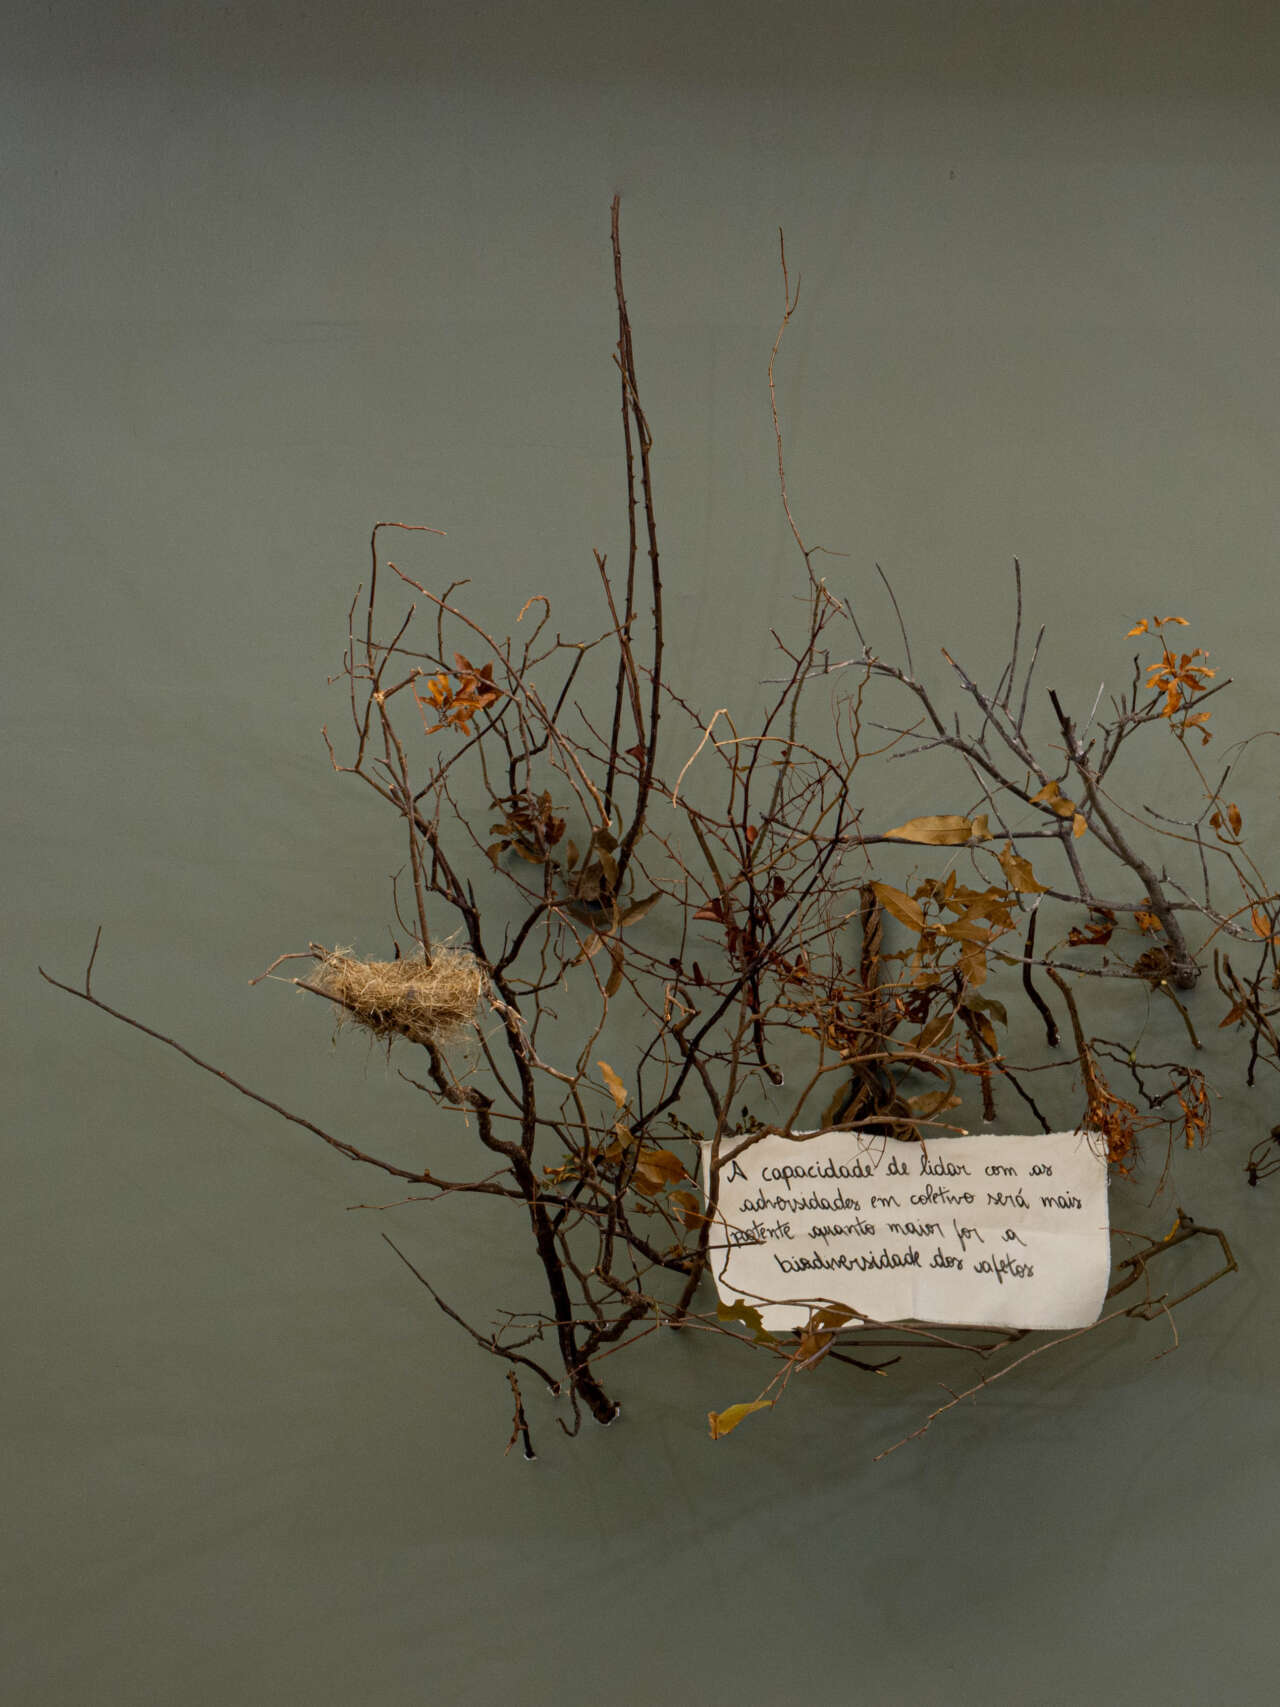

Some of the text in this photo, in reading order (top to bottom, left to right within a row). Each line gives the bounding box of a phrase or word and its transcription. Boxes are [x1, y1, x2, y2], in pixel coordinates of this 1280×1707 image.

[727, 1155, 1053, 1190] A capacidade de lidar com as
[870, 1194, 900, 1209] em
[910, 1184, 976, 1205] coletivo
[987, 1188, 1030, 1210] será
[1041, 1191, 1082, 1210] mais
[808, 1217, 875, 1246] quanto
[888, 1219, 945, 1239] maior
[953, 1219, 984, 1252] for
[1001, 1228, 1027, 1247] a
[774, 1246, 1034, 1284] biodiversidade dos afetos
